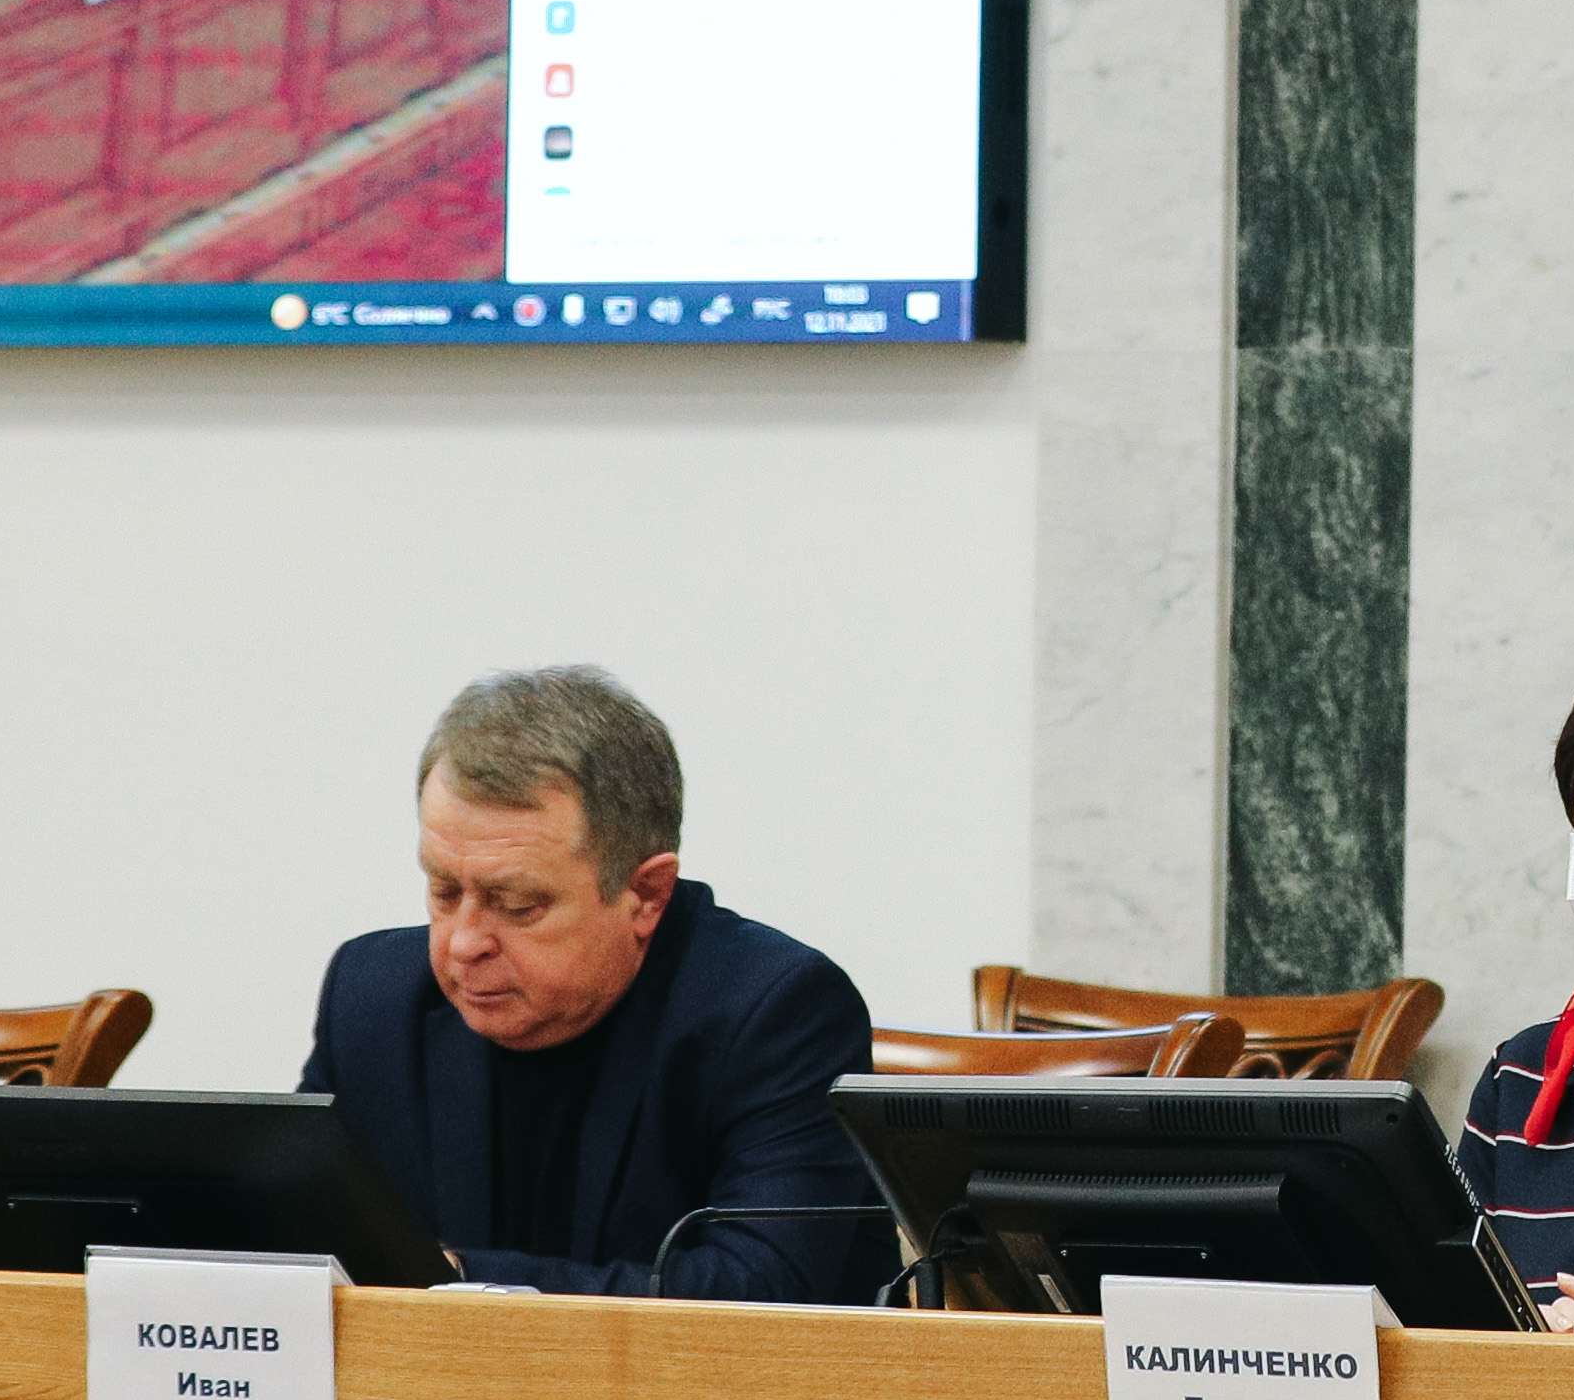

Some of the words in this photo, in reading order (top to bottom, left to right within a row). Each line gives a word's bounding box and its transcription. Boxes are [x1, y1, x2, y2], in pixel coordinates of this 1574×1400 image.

[137, 1323, 280, 1351] КОВАЛЕВ
[1125, 1344, 1358, 1379] КАЛИНЧЕНКО
[177, 1372, 250, 1399] Иван
